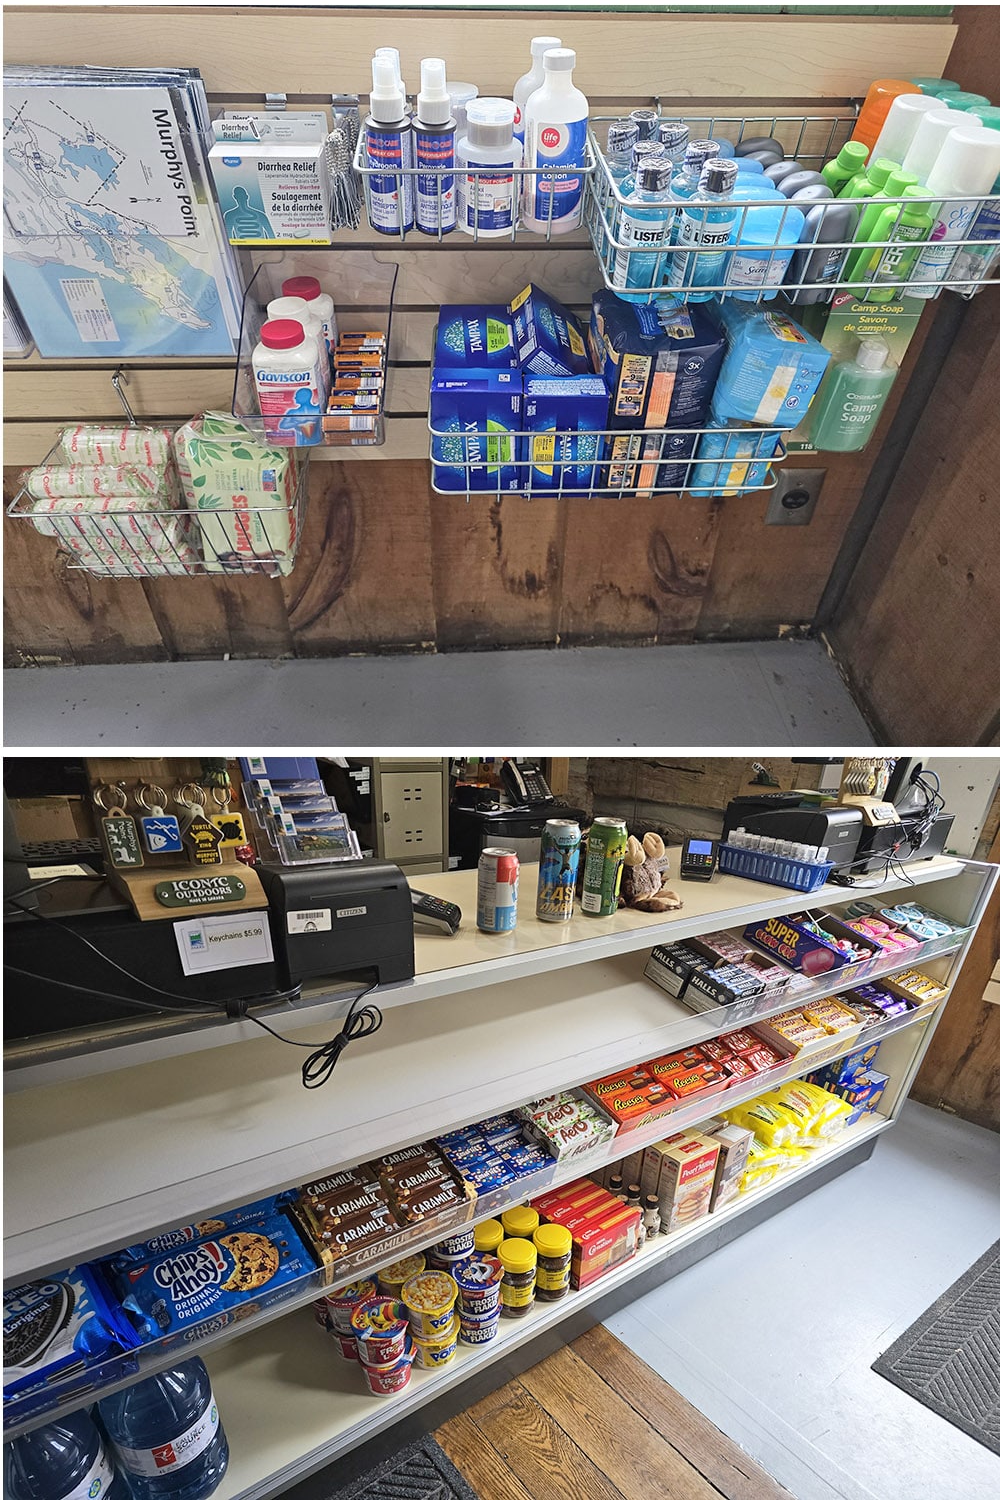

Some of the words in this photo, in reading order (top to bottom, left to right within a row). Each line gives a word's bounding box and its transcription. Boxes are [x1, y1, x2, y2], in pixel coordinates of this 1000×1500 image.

[223, 132, 243, 140] Relief
[544, 133, 558, 141] Life
[152, 108, 186, 191] Murphys
[258, 162, 290, 172] Diarrhea
[294, 162, 316, 172] Relief
[272, 192, 321, 202] Soulagement
[179, 194, 200, 237] Point
[272, 203, 280, 212] de
[282, 203, 290, 212] la
[292, 203, 323, 212] diarrhée
[851, 304, 878, 314] Camp
[880, 304, 904, 314] Soap
[844, 324, 856, 332] de
[857, 324, 898, 334] camping
[859, 316, 888, 324] Savon
[470, 319, 484, 354] TAMPAX
[256, 370, 310, 384] Gaviscon
[843, 402, 878, 413] Camp
[840, 412, 871, 424] Soap
[118, 826, 126, 841] Point
[126, 820, 136, 850] Murphys
[176, 886, 232, 900] OUTDOORS
[338, 907, 365, 916] CITIZEN
[208, 930, 243, 944] Keychains
[244, 928, 263, 940] $5.99
[766, 918, 800, 948] SUPER
[652, 948, 674, 970] HALLS
[692, 976, 716, 997] HALLS
[682, 1167, 698, 1180] Pearl
[698, 1159, 716, 1172] Milling
[328, 1192, 379, 1218] CARAMILK
[412, 1189, 454, 1214] CARAMILK
[334, 1218, 386, 1244] CARAMILK
[154, 1249, 209, 1288] Chips
[3, 1282, 59, 1321] REO
[175, 1286, 216, 1311] ORIGINAL
[178, 1290, 223, 1320] ORIGINAUX
